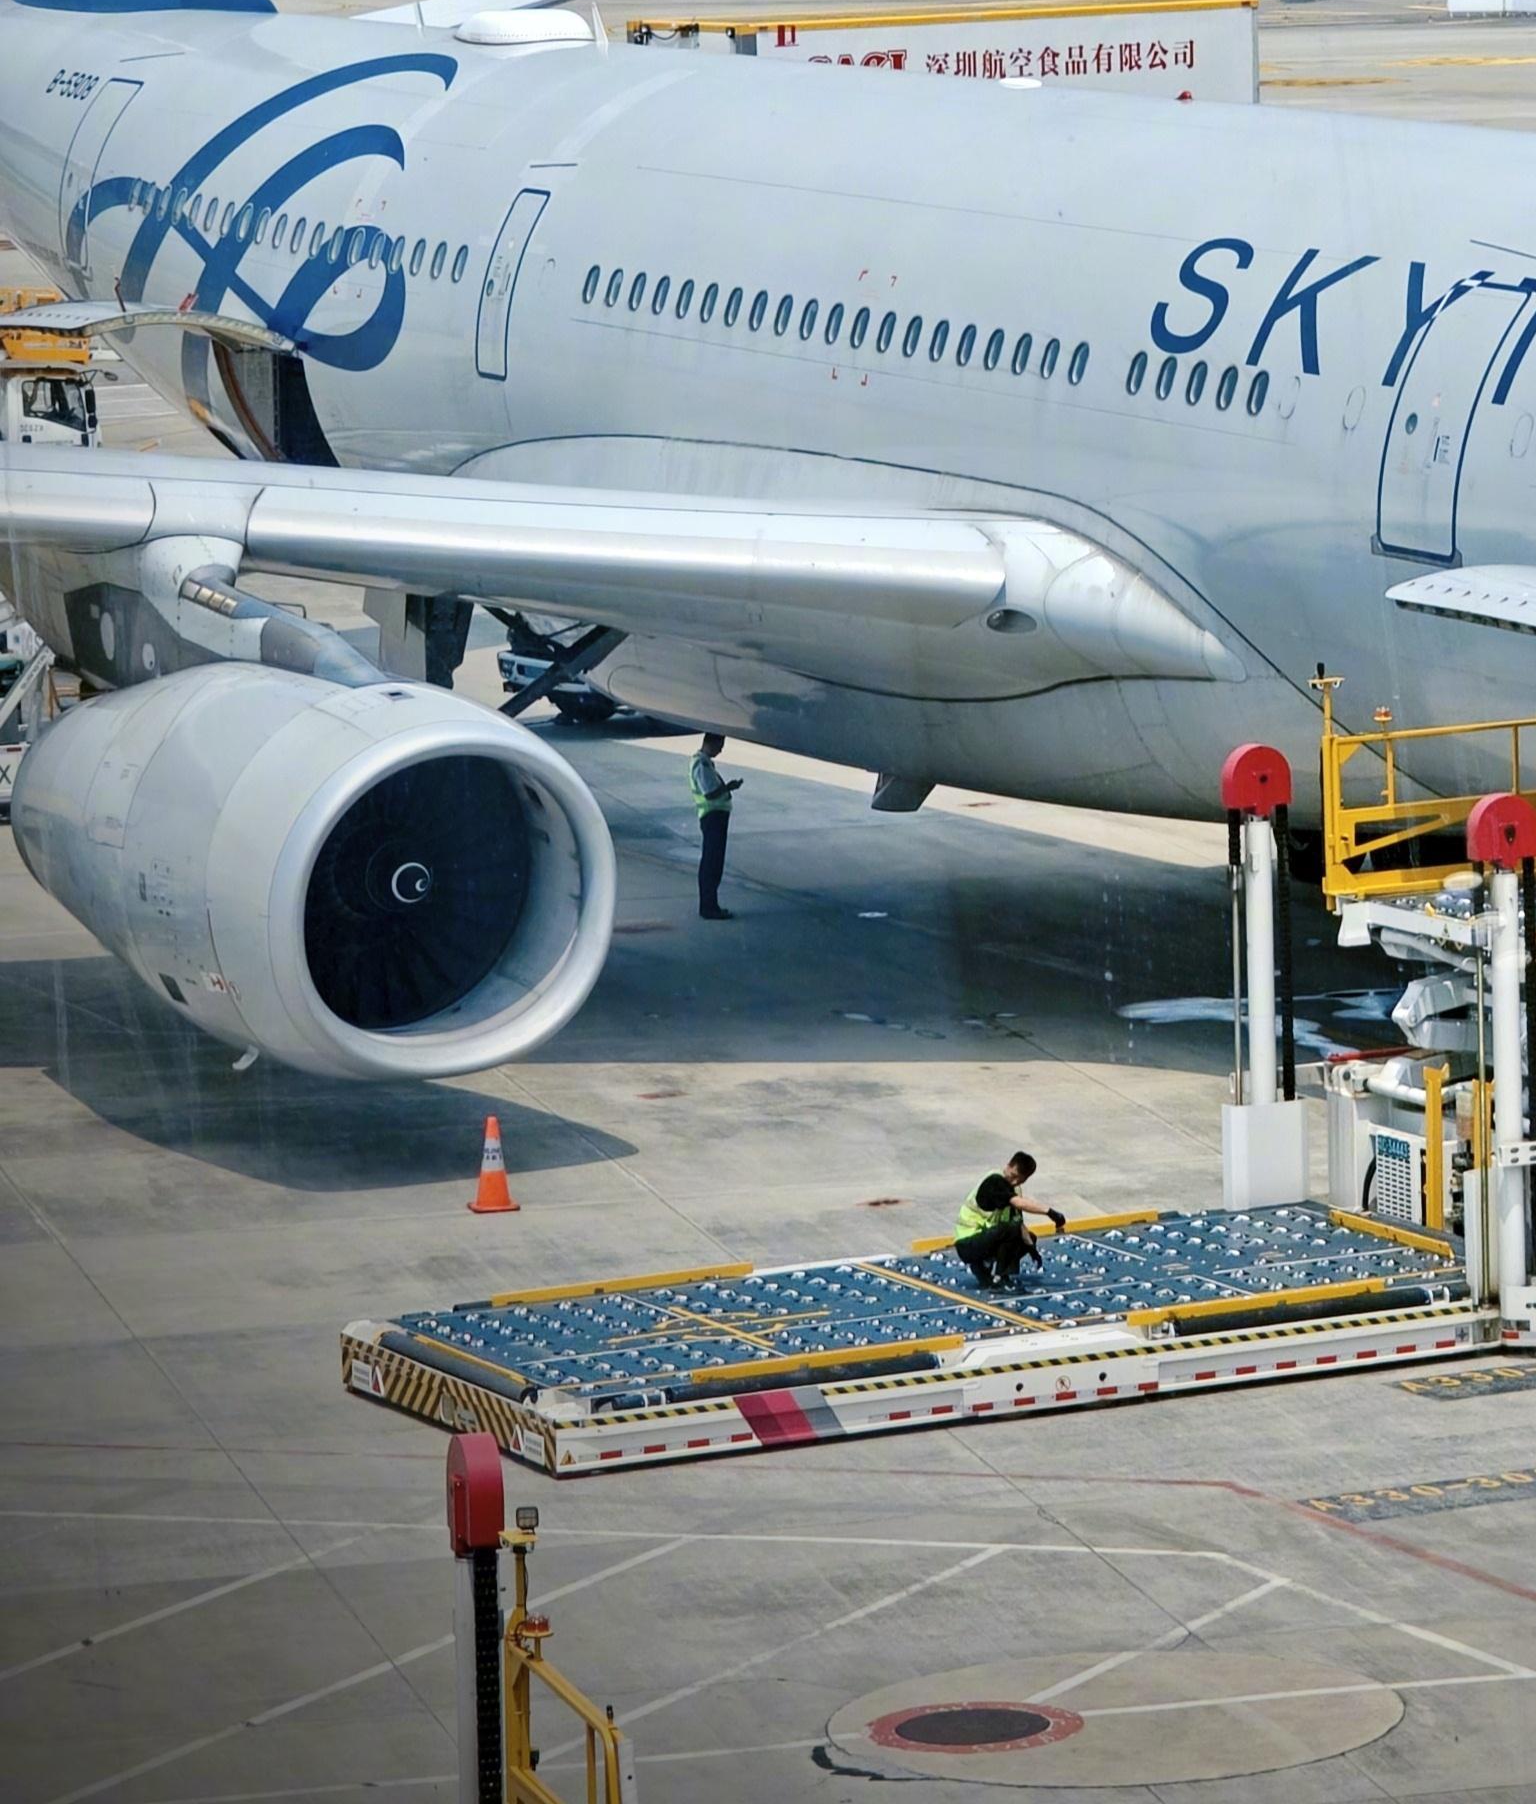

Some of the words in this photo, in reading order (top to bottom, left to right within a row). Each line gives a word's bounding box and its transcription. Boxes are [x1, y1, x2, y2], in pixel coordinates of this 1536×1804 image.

[925, 39, 1195, 79] 深圳航空食品有限公司
